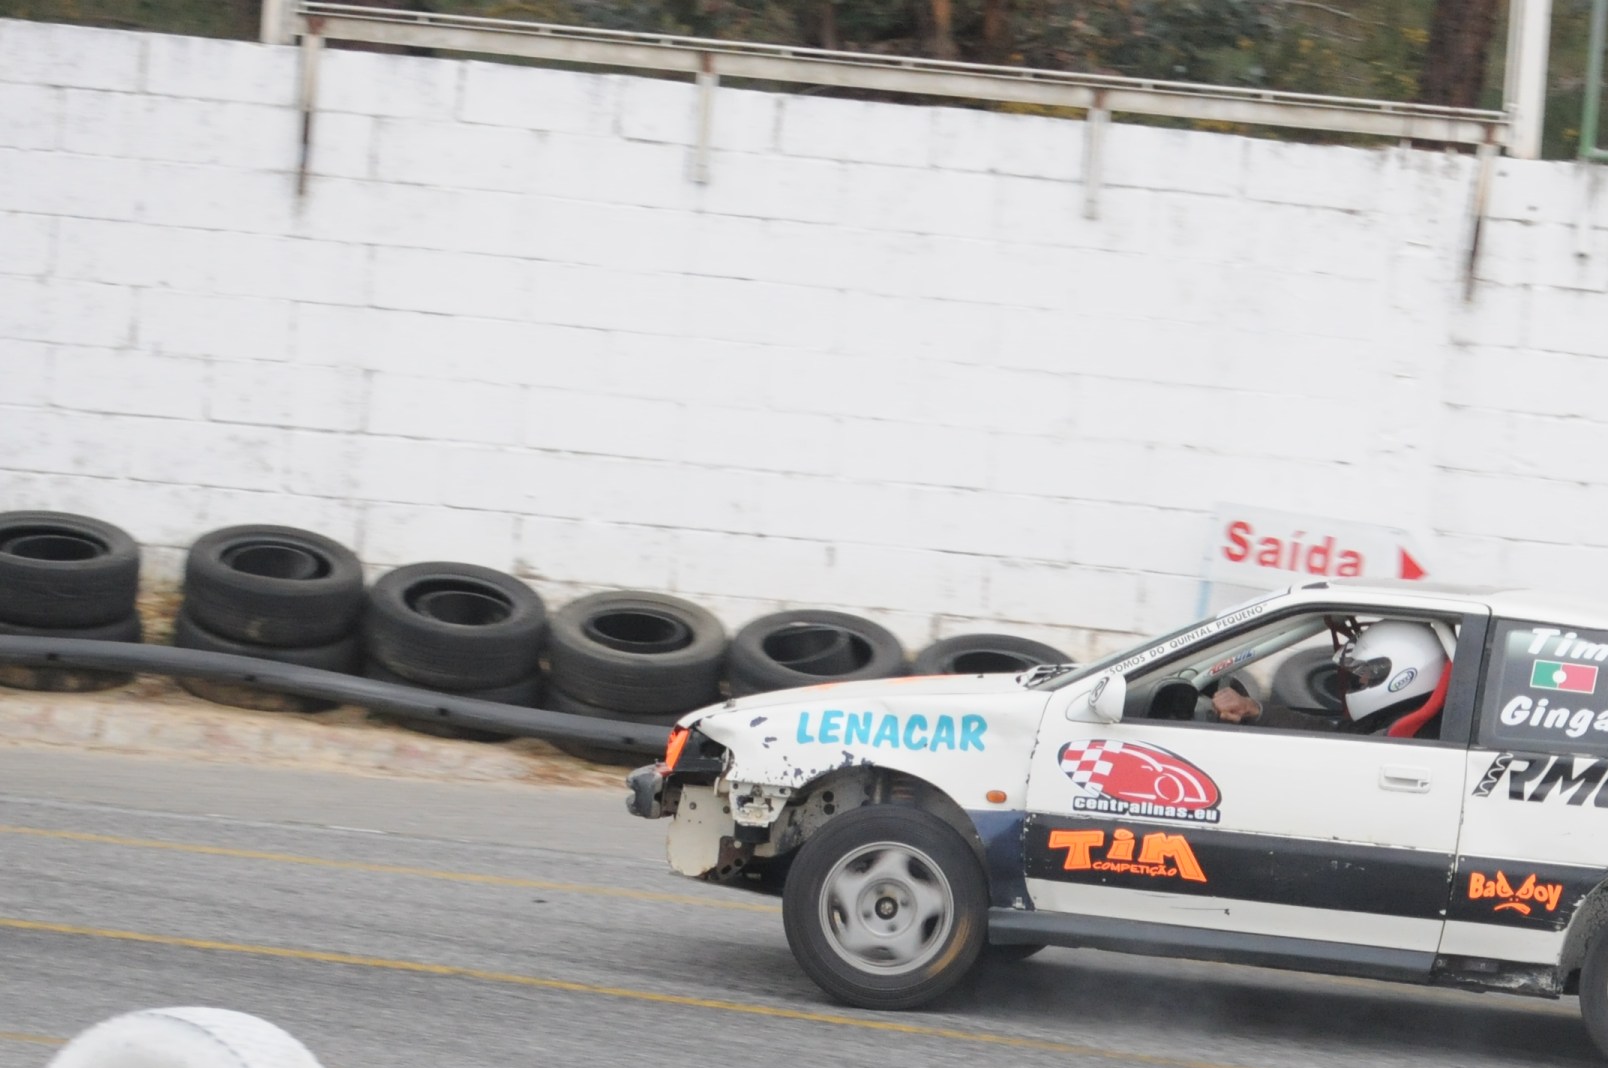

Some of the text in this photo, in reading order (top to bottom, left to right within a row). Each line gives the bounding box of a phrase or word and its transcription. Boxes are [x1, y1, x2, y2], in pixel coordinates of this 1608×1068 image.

[1222, 520, 1363, 577] Saída
[1150, 646, 1165, 658] DO
[1169, 626, 1213, 648] QUINTAL
[796, 710, 988, 752] LENACAR
[1073, 797, 1219, 821] centralinas.eu
[1092, 861, 1178, 877] COMPETIÇÃO
